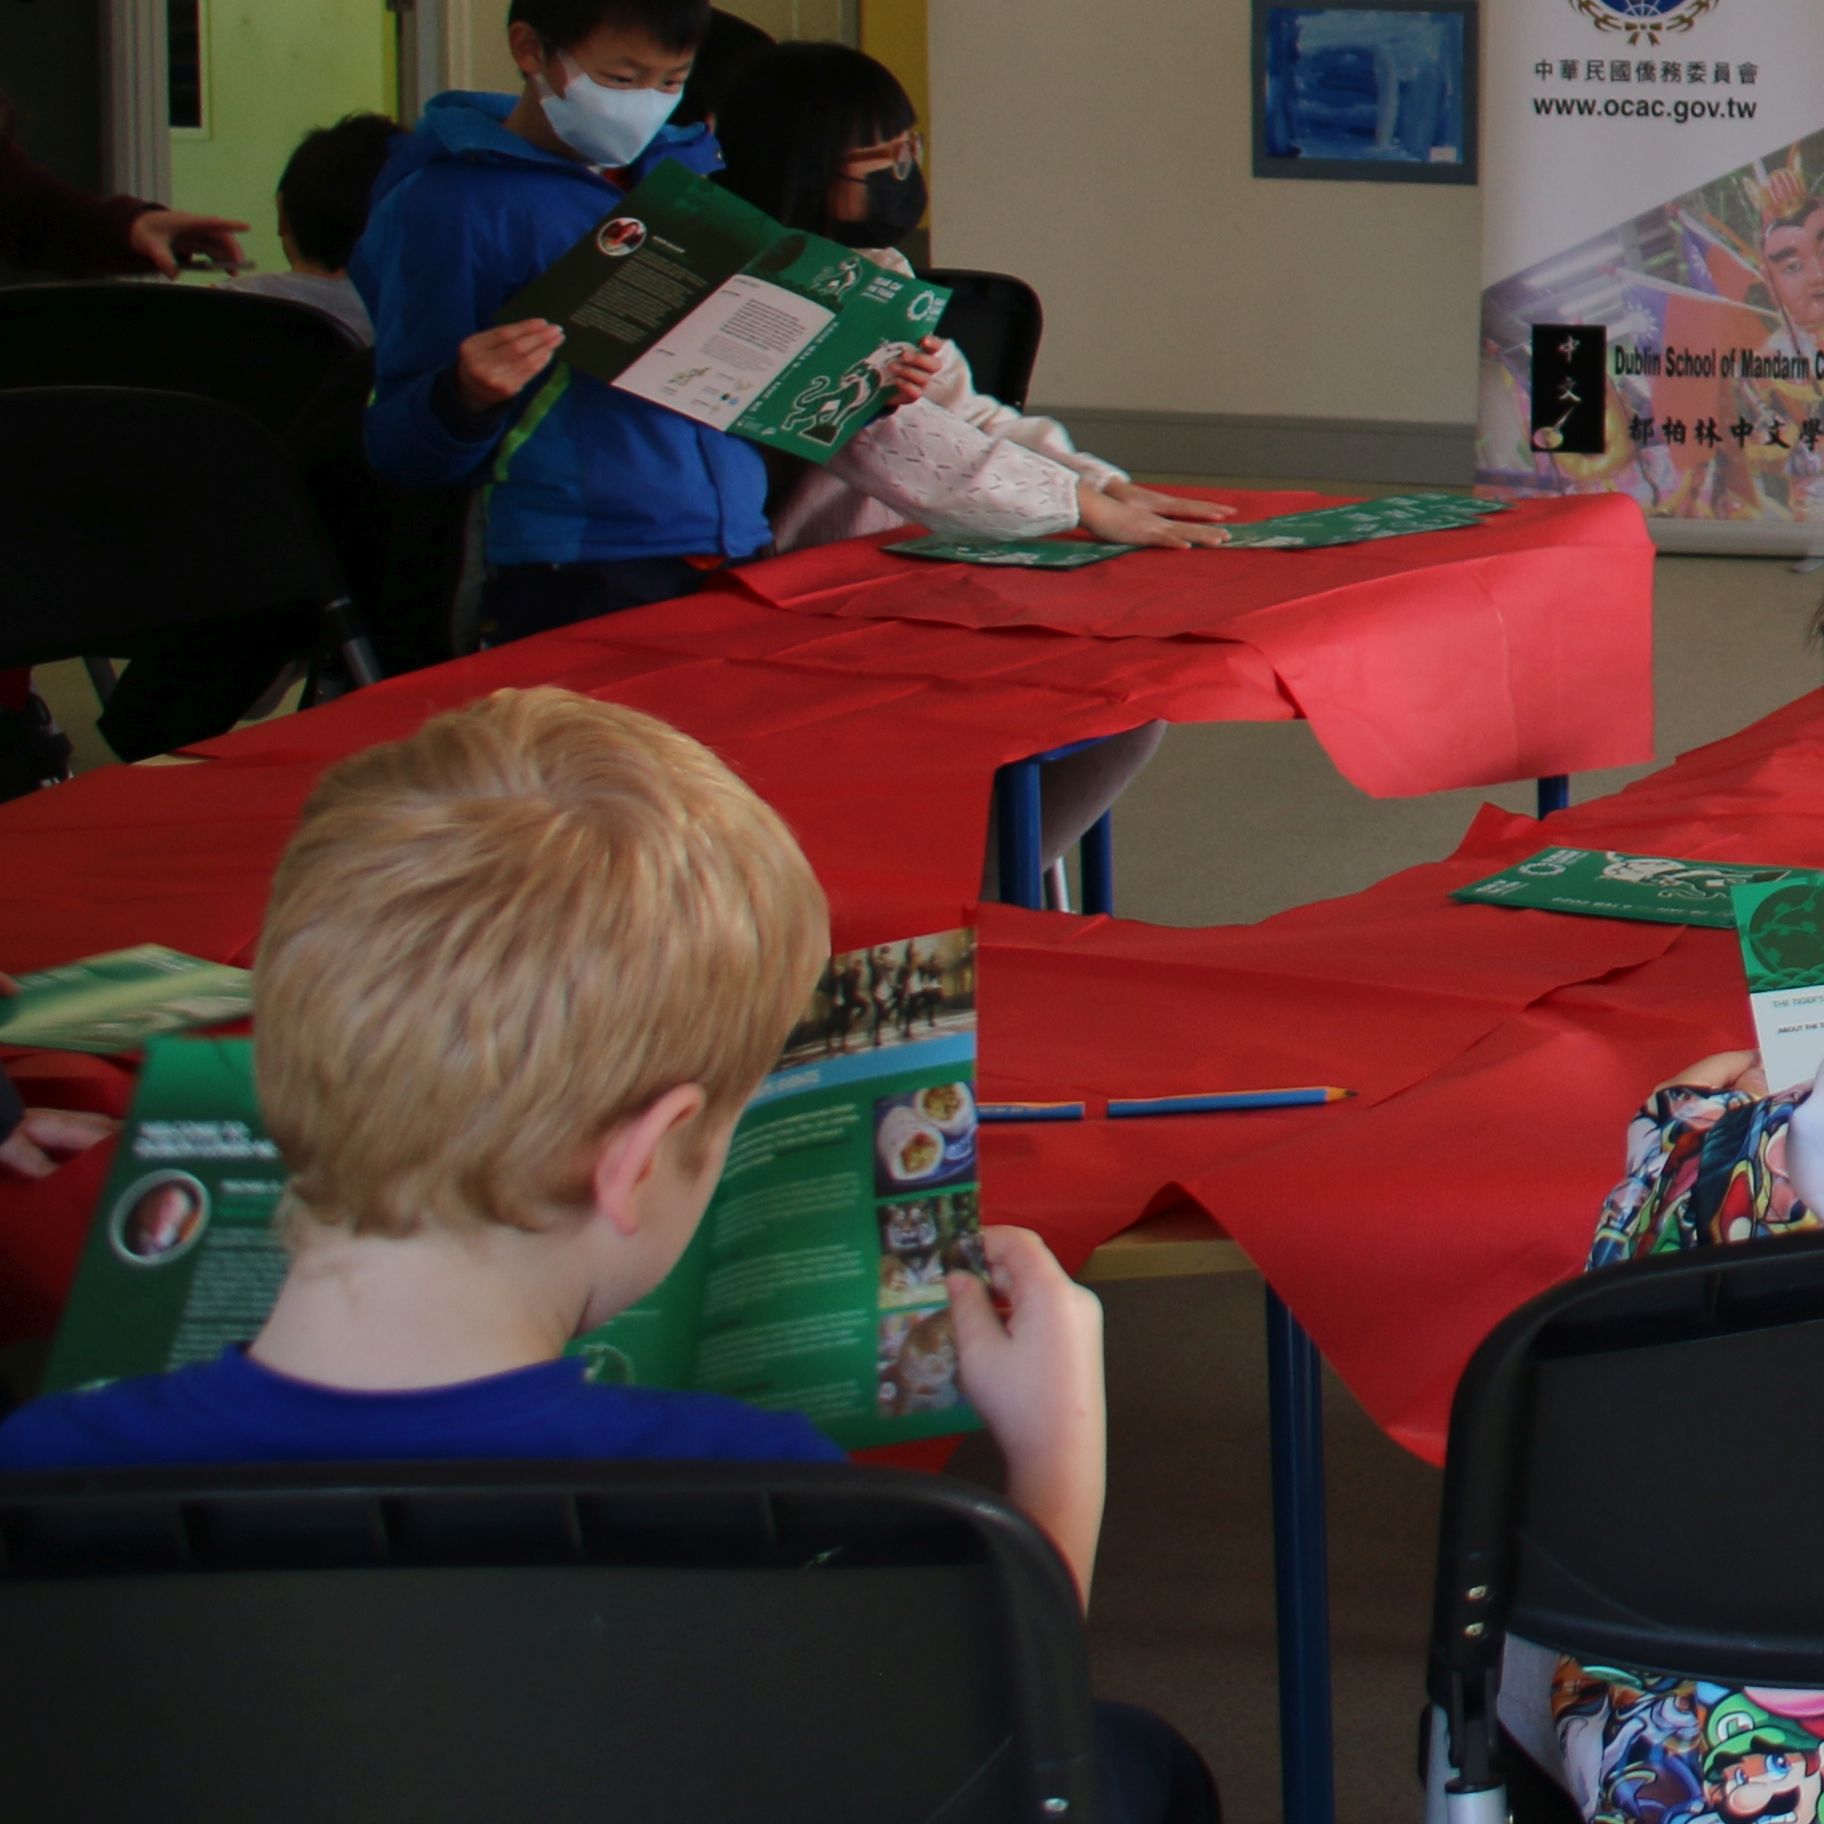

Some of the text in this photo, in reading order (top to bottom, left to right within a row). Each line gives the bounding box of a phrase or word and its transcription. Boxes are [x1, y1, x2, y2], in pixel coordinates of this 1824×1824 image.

[1534, 58, 1760, 85] 中華民國僑務委員會
[1533, 96, 1758, 125] www.ocac.gov.tw
[1614, 344, 1661, 377] Dublin
[1665, 346, 1717, 378] School
[1721, 348, 1736, 378] of
[1741, 348, 1810, 379] Mandarin
[1773, 998, 1790, 1008] THE
[1793, 995, 1824, 1007] TIGER'S
[1778, 1024, 1803, 1034] ABOUT
[1805, 1022, 1819, 1031] THE
